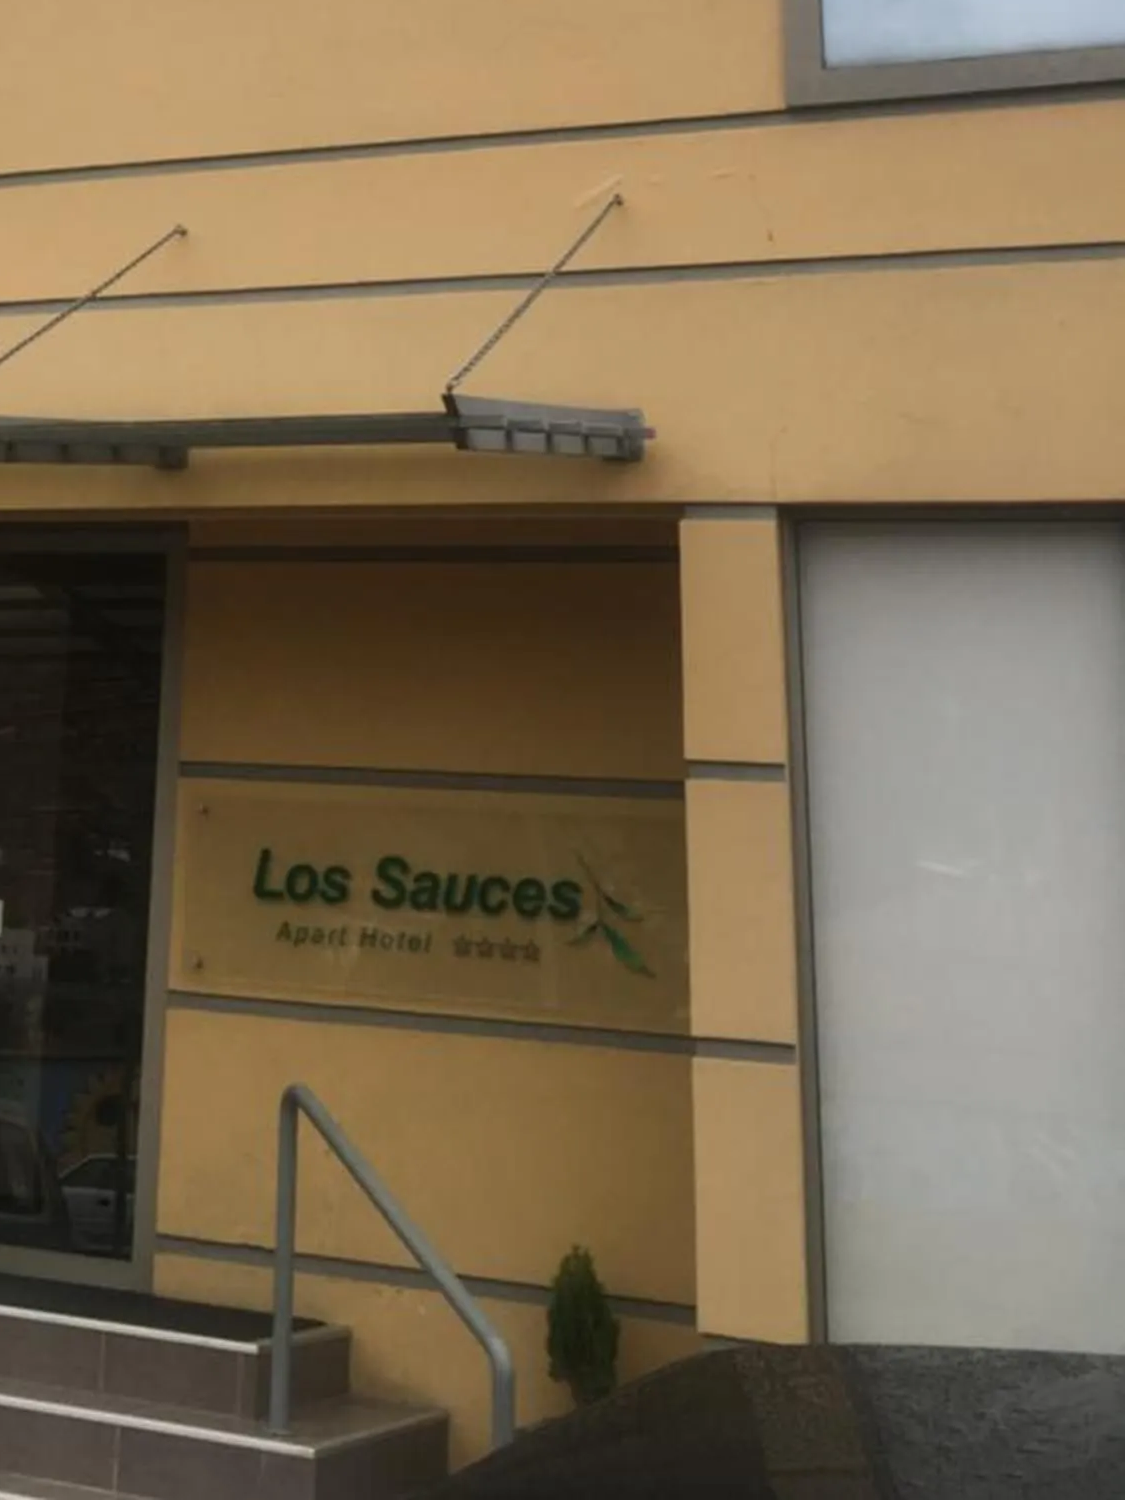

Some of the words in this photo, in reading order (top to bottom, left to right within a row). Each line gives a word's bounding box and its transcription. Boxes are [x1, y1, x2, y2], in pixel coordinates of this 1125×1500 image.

[253, 848, 352, 903] Los
[371, 855, 583, 921] Sauces
[275, 920, 349, 948] Apart
[359, 927, 432, 954] Hotel
